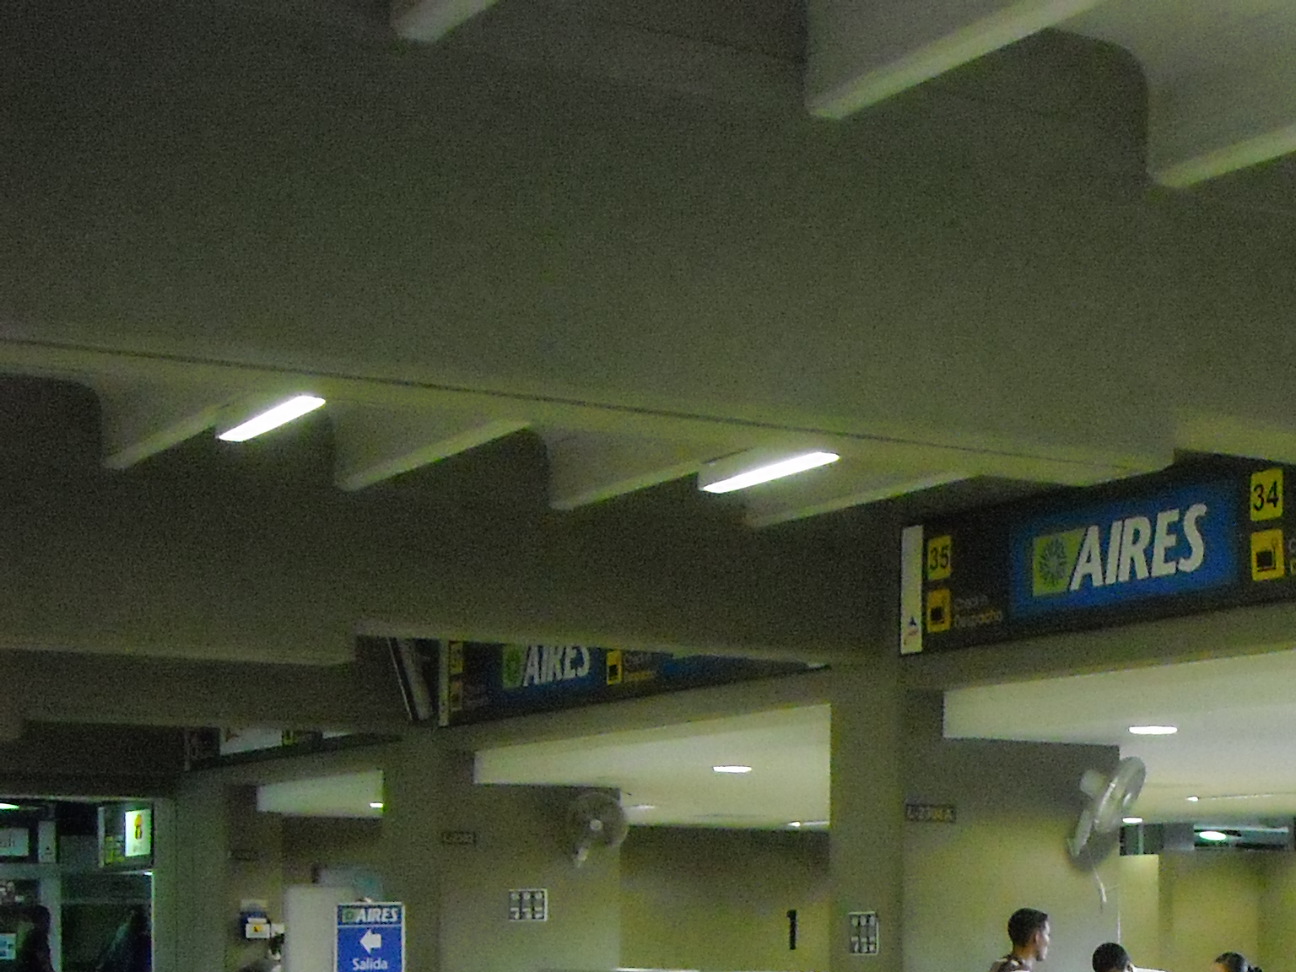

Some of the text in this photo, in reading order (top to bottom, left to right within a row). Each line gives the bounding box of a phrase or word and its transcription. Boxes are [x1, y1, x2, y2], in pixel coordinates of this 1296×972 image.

[1253, 480, 1280, 511] 34
[929, 546, 949, 571] 35
[1069, 503, 1208, 592] AIRES
[522, 643, 590, 687] AIRES
[355, 907, 399, 923] AIRES
[352, 957, 389, 971] Salida
